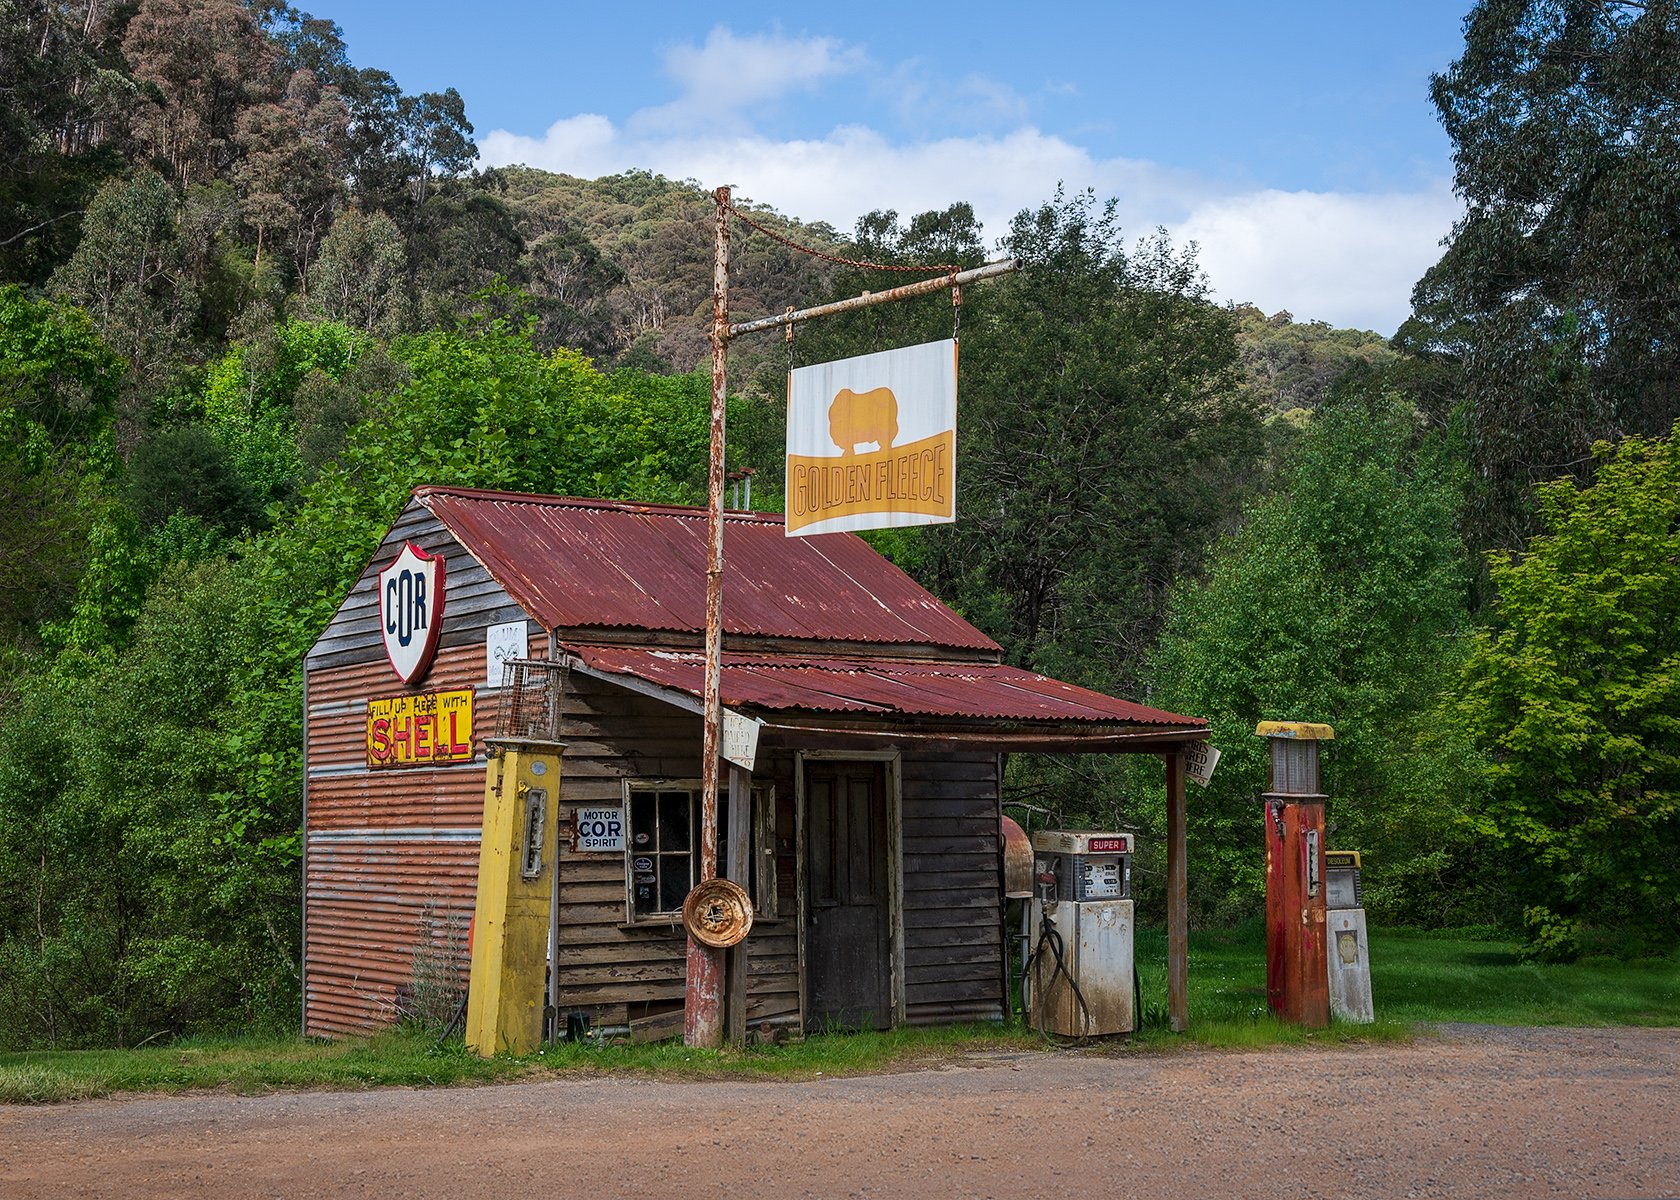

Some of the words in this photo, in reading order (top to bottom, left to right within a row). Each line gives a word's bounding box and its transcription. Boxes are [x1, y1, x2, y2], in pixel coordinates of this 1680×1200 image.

[793, 463, 871, 516] GOLDEN
[875, 443, 946, 504] FLEECE
[371, 704, 390, 716] FILL
[394, 701, 407, 713] UP
[414, 699, 437, 713] HERE
[442, 696, 468, 708] WITH
[371, 711, 469, 761] SHELL
[584, 811, 618, 820] MOTOR
[579, 821, 624, 838] C.O.R.
[585, 838, 617, 847] SPIRIT
[1093, 840, 1119, 849] SUPER
